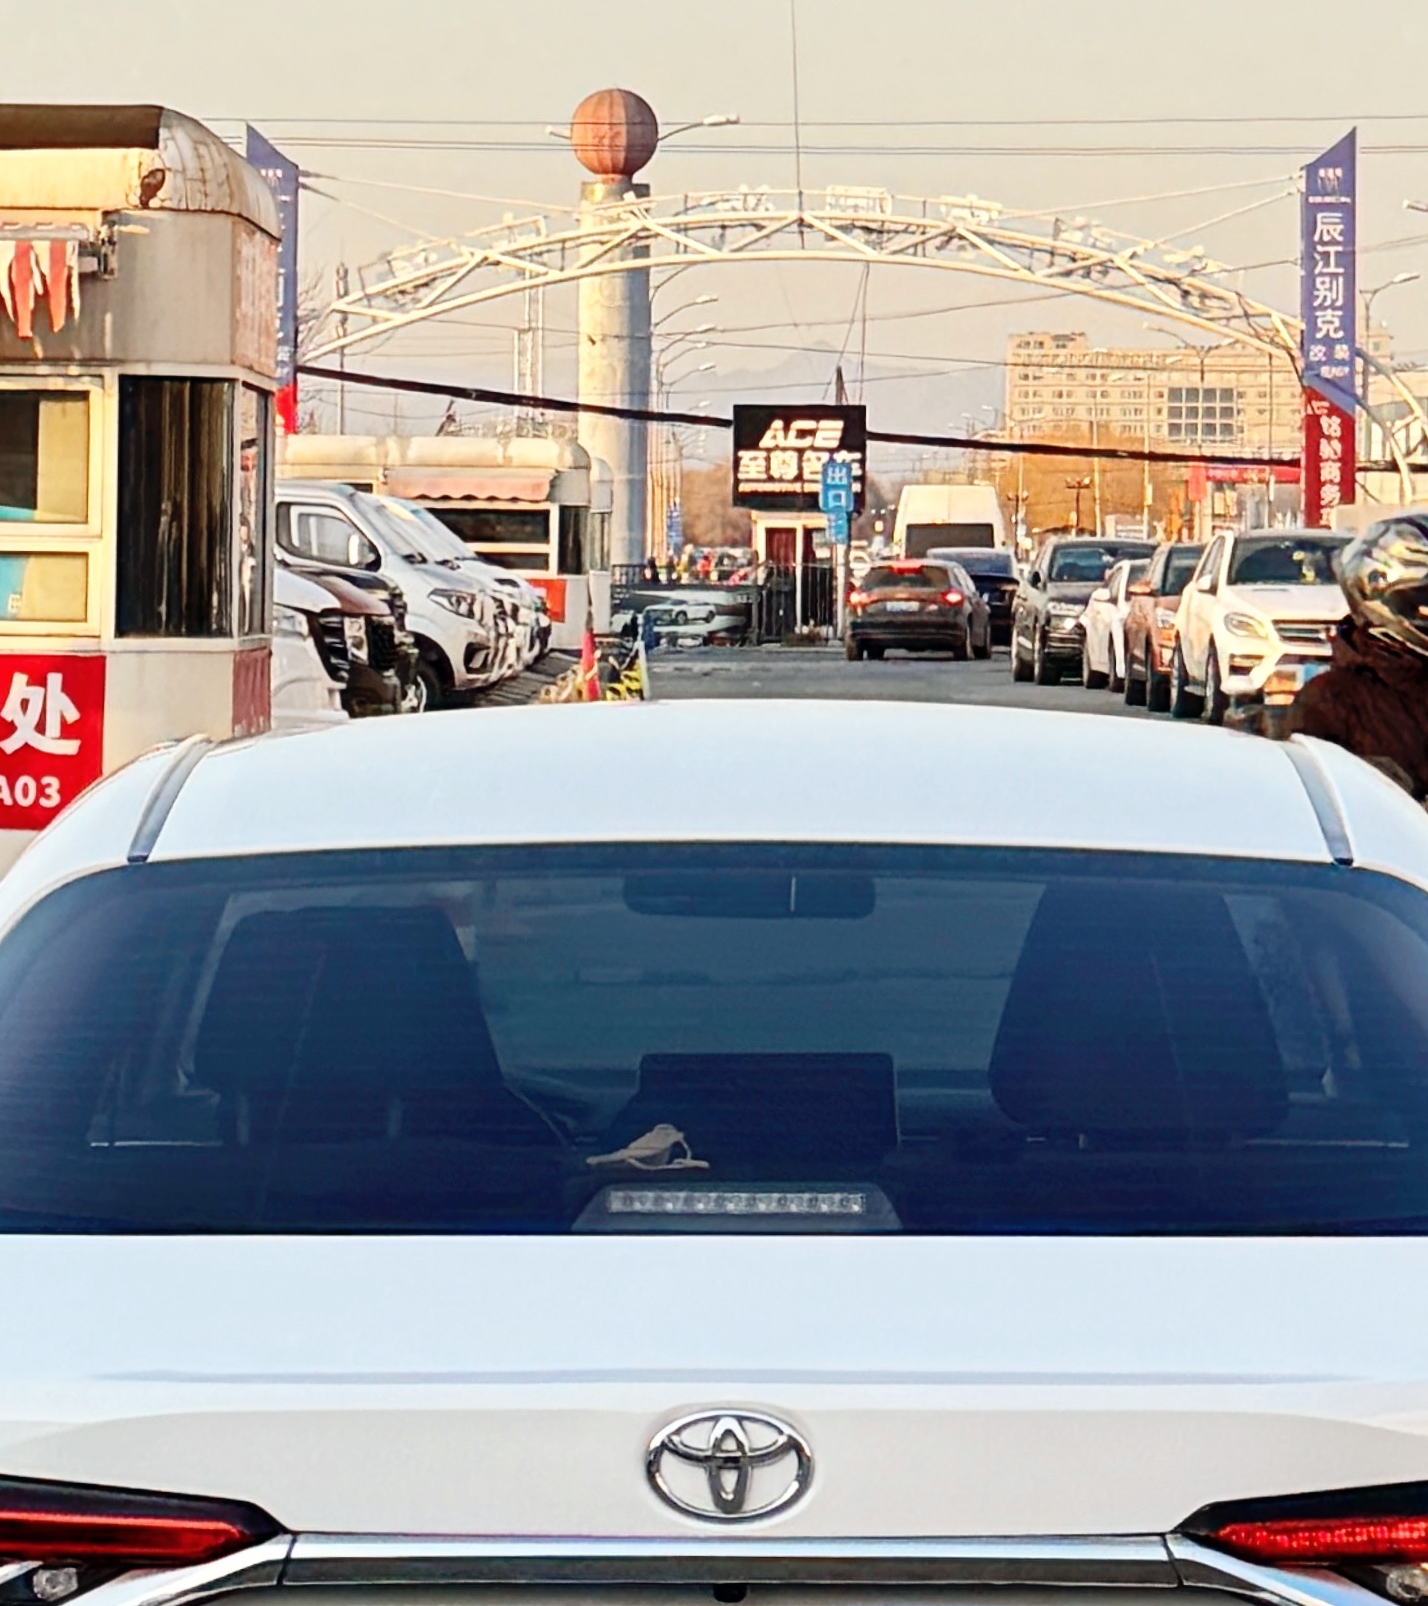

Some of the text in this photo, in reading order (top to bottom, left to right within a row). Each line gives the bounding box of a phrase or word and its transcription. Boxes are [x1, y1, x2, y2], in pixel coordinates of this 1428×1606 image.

[1313, 212, 1345, 339] 辰江别克
[759, 419, 844, 449] ACE
[827, 466, 848, 508] 出口
